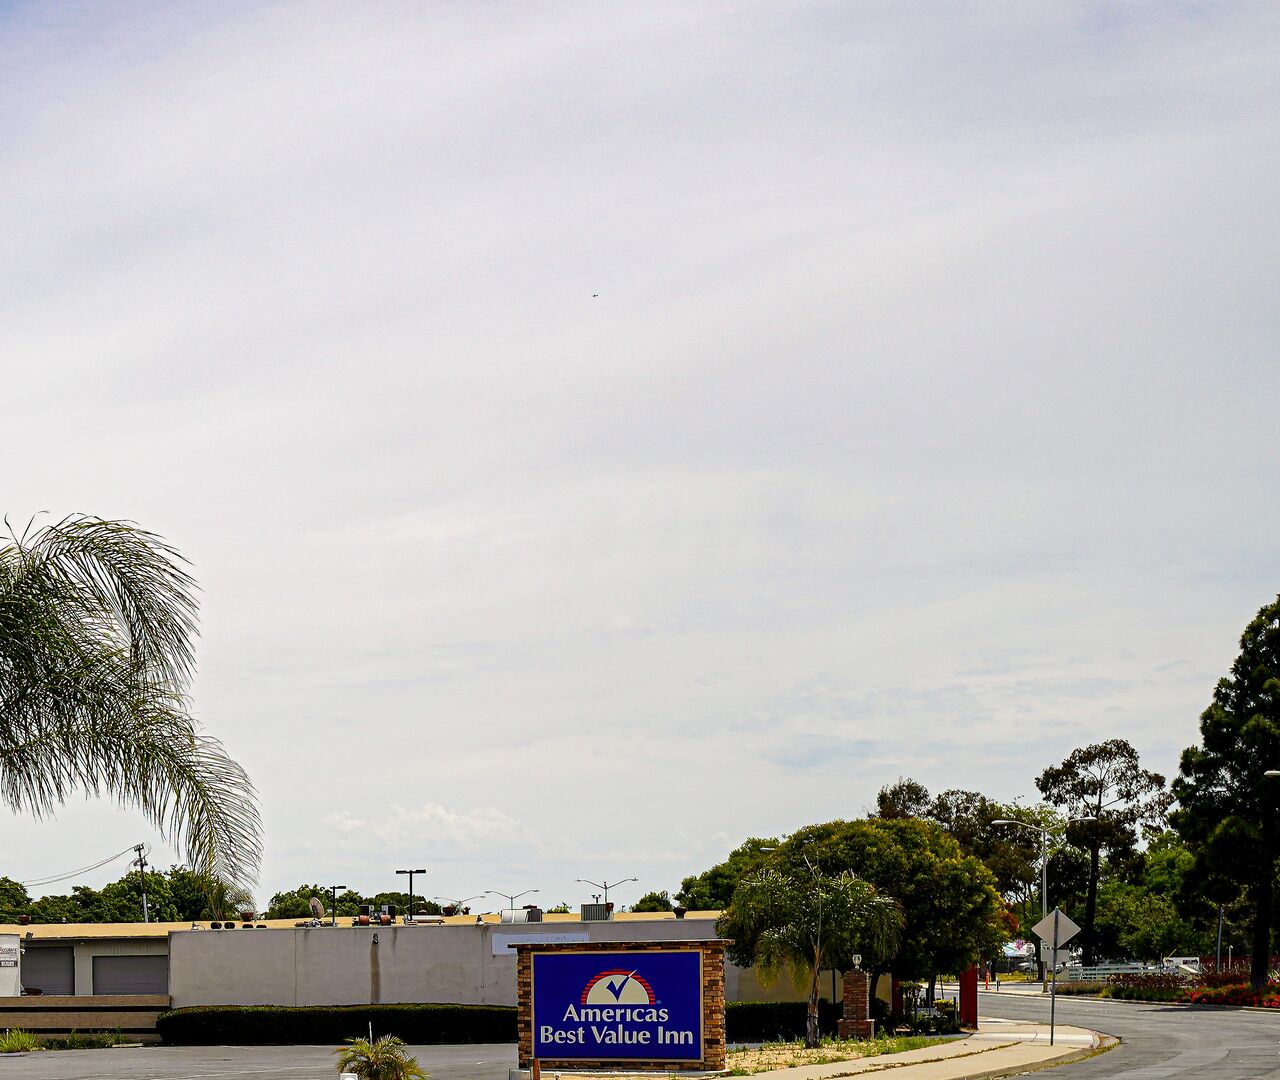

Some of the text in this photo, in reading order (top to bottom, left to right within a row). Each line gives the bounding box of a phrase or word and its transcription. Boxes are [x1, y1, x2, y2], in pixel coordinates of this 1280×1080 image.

[562, 1003, 669, 1022] Americas
[540, 1024, 694, 1045] Best Value Inn
